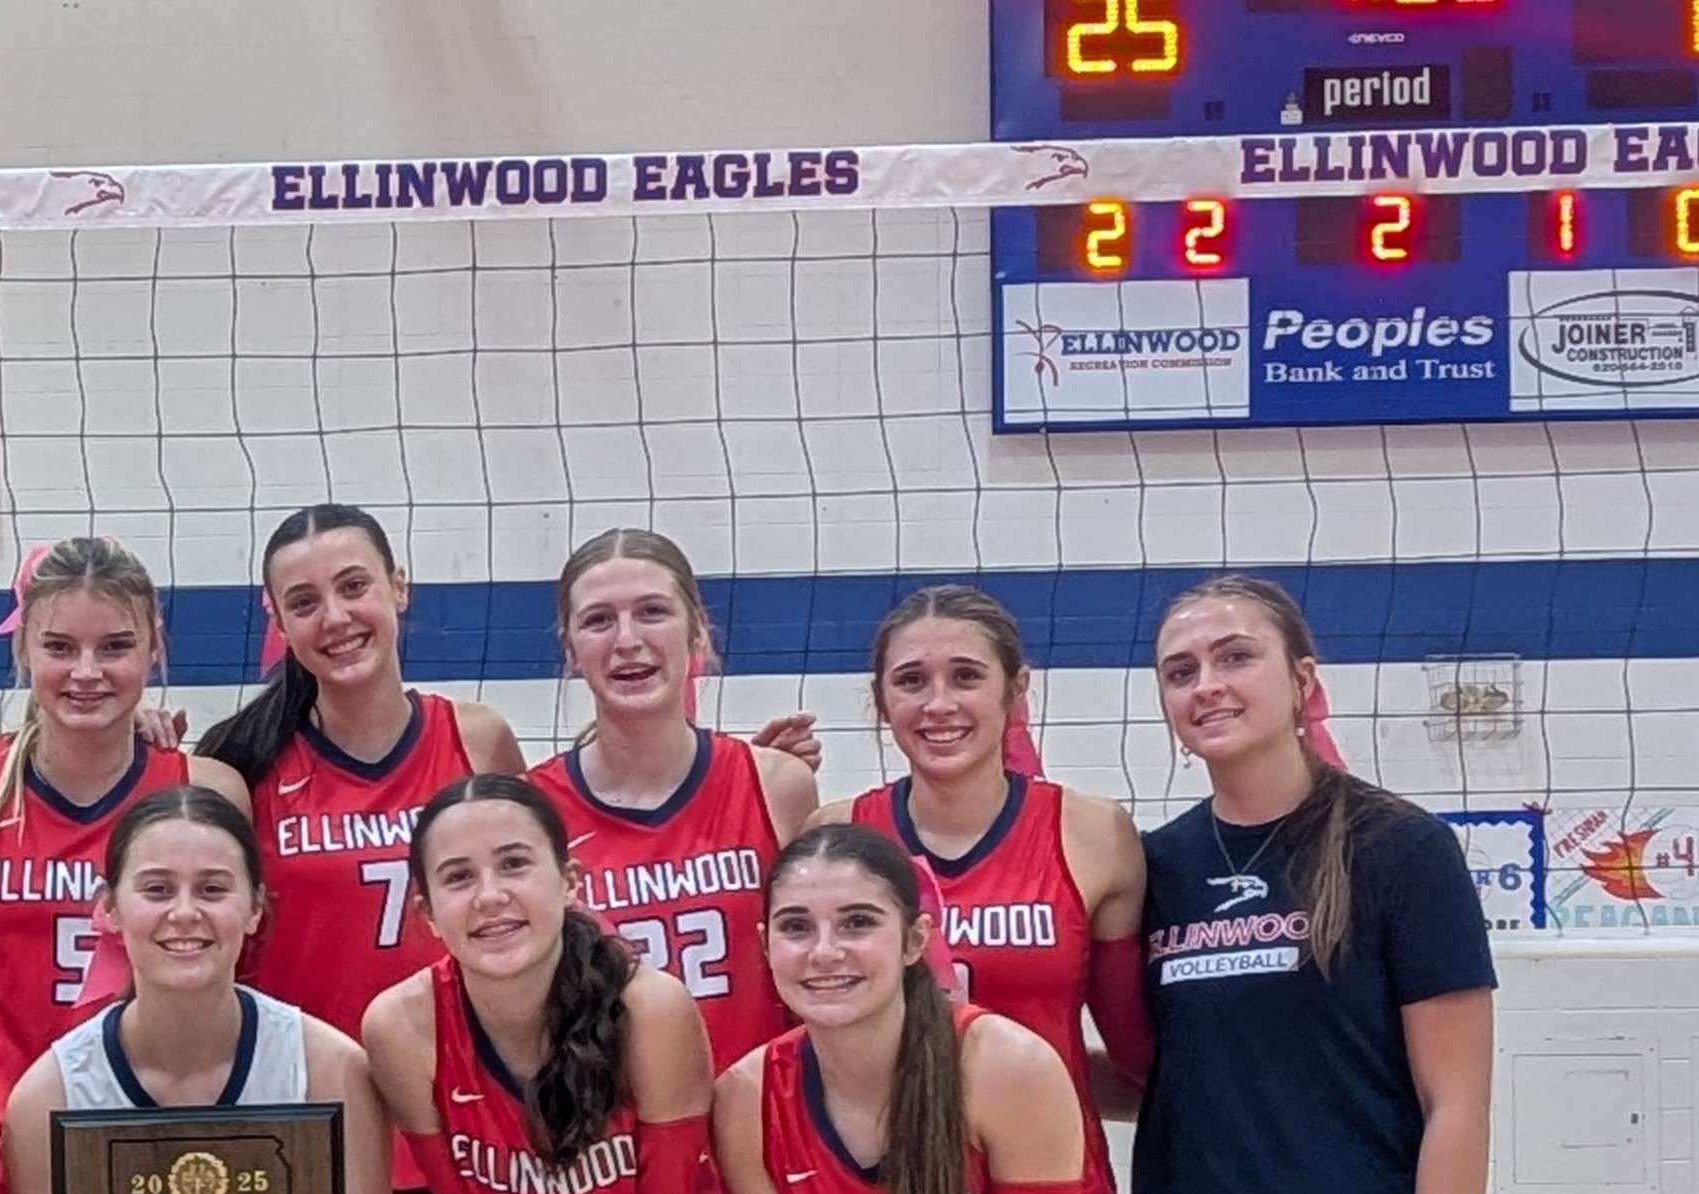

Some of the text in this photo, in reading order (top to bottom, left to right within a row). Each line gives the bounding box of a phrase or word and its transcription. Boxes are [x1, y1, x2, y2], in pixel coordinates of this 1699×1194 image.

[1324, 67, 1429, 115] period
[271, 150, 859, 210] ELLINWOOD EAGLES
[1240, 125, 1699, 183] ELLINWOOD EA
[1087, 203, 1126, 267] 2
[1185, 201, 1224, 264] 2
[1372, 196, 1411, 260] 2
[1558, 194, 1574, 254] 1
[1061, 329, 1241, 355] ELLINWOOD
[1263, 306, 1495, 357] Peoples
[1551, 323, 1646, 354] JOINER
[1567, 347, 1683, 362] CONSTRUCTION
[1263, 358, 1496, 383] Bank and Trust
[278, 807, 424, 855] ELLINW
[361, 860, 411, 946] 7
[584, 849, 761, 911] LLINWOOD
[54, 916, 101, 1002] 5
[1170, 952, 1287, 977] VOLLEYBALL
[237, 1170, 269, 1192] 25
